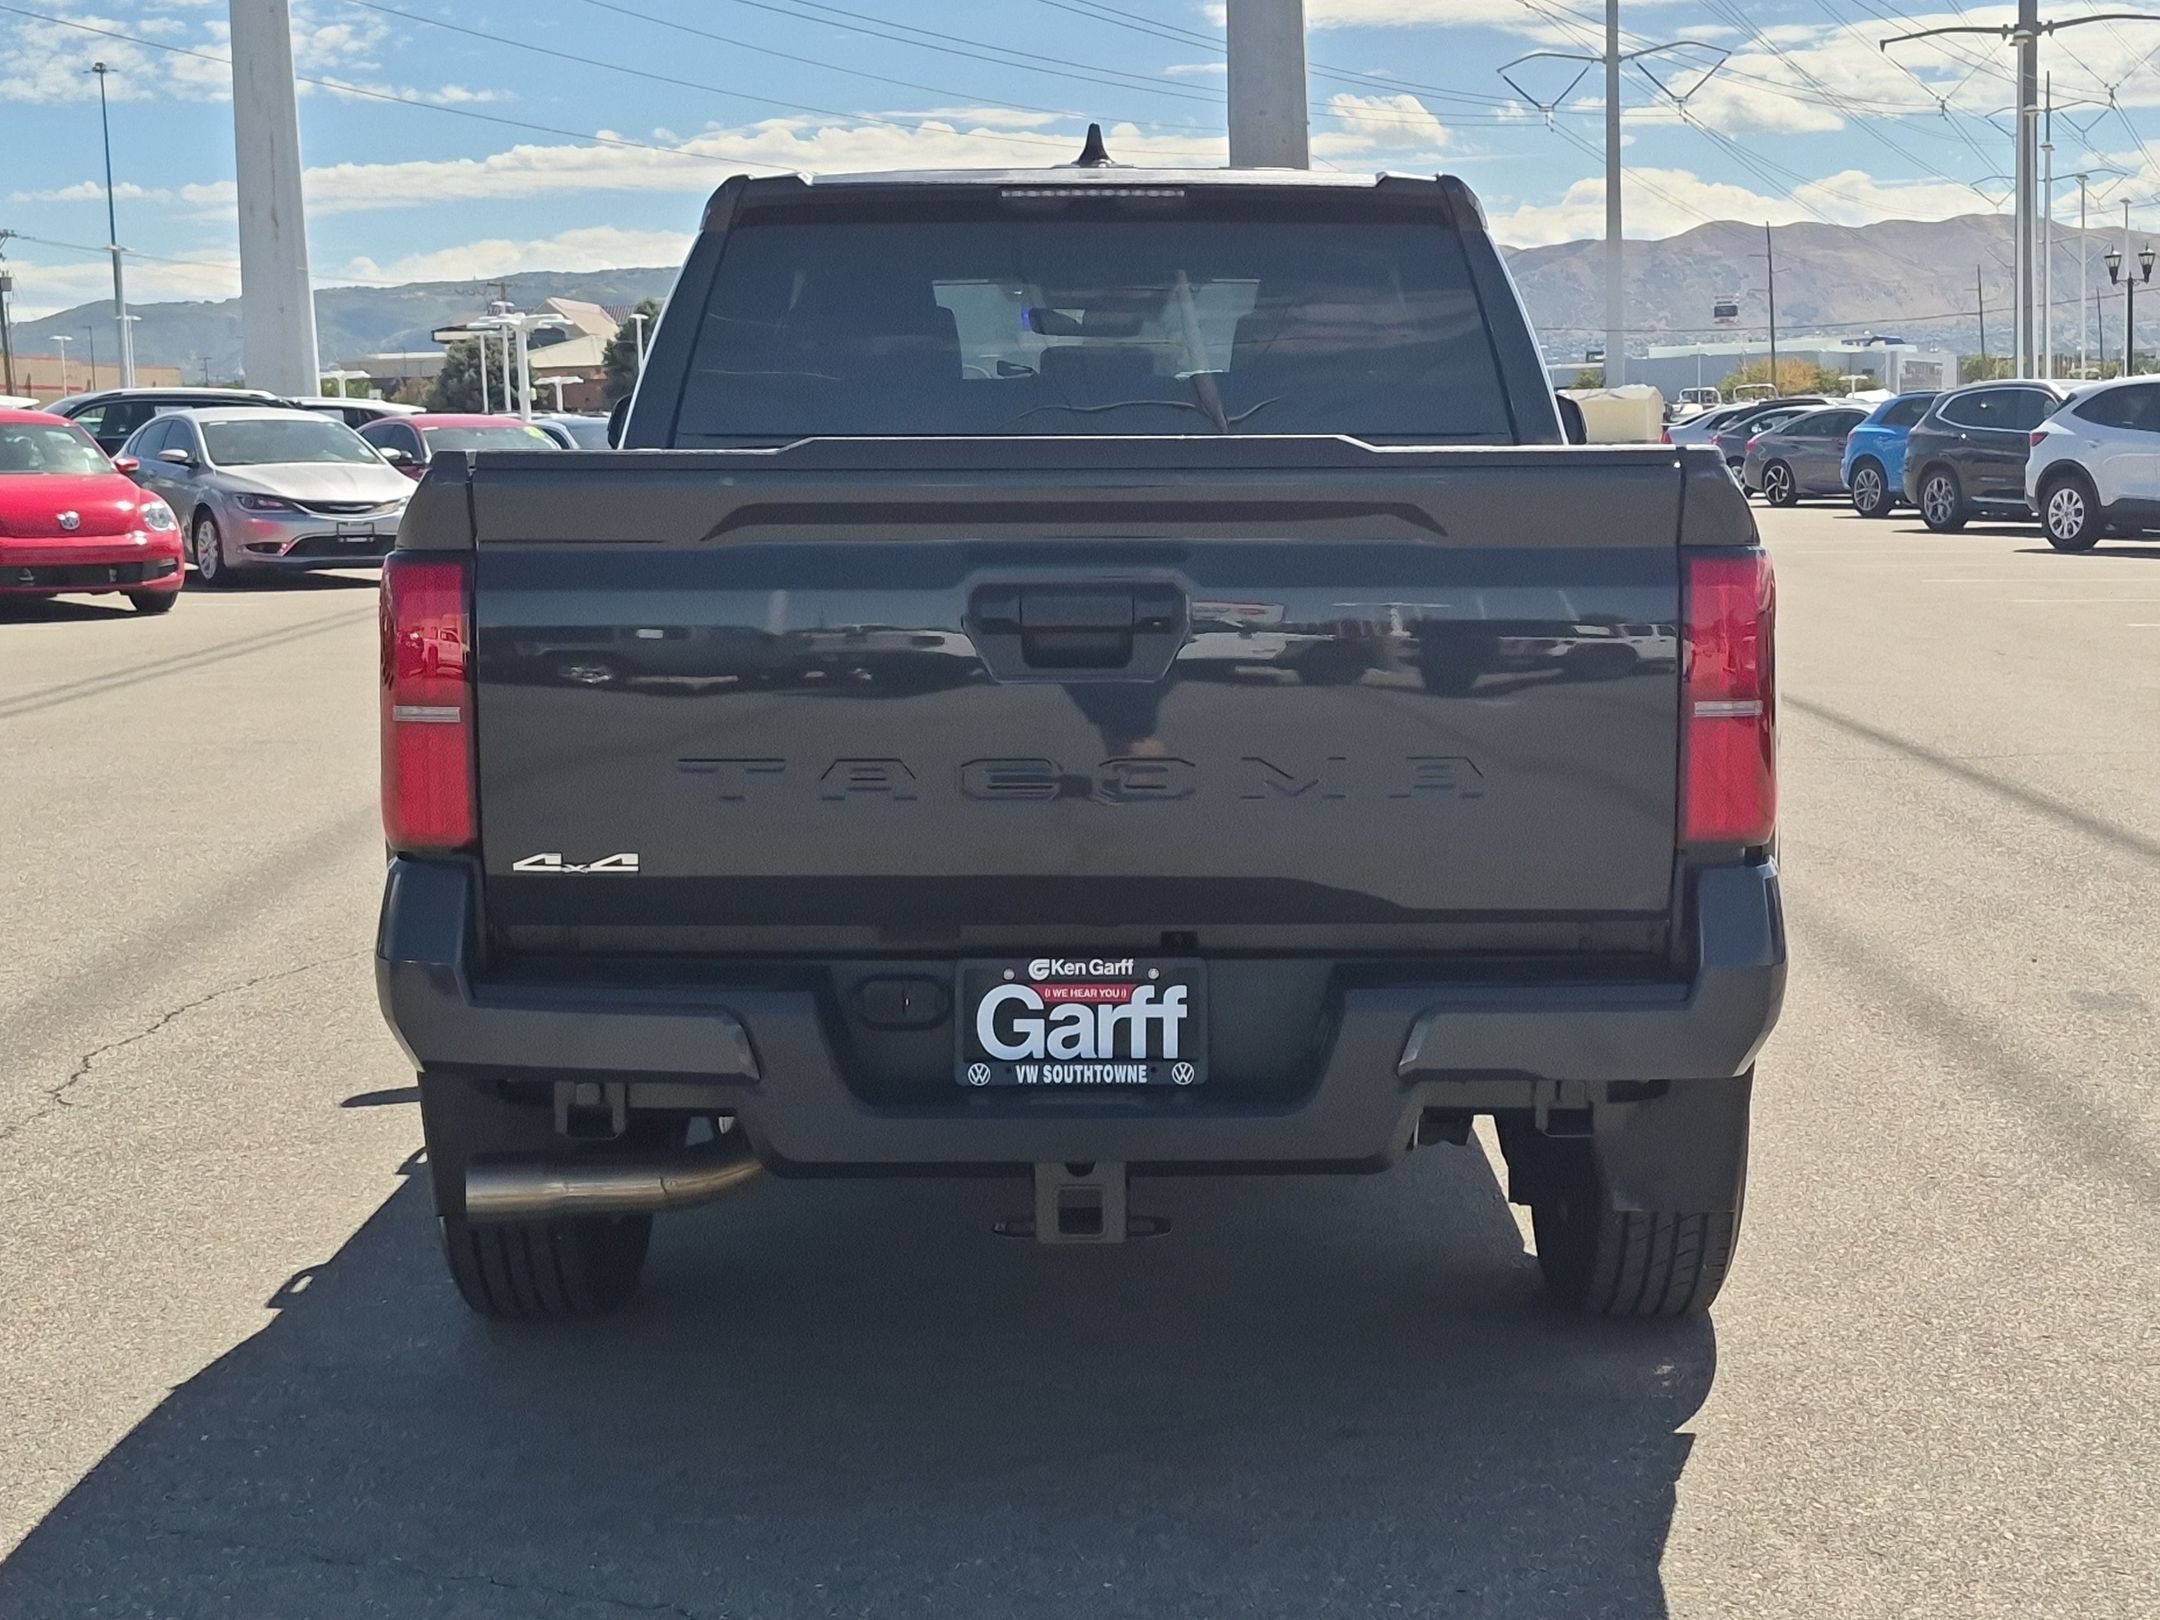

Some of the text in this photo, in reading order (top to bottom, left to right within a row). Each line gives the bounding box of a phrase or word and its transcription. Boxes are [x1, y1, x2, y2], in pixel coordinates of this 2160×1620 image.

[678, 757, 1483, 801] TACOMA
[1051, 958, 1086, 976] Ken
[1089, 958, 1135, 976] Garff
[1052, 988, 1120, 998] WE HEAR YOU
[976, 983, 1188, 1060] Garff
[1015, 1064, 1148, 1084] VW SOUTHTOWNE
